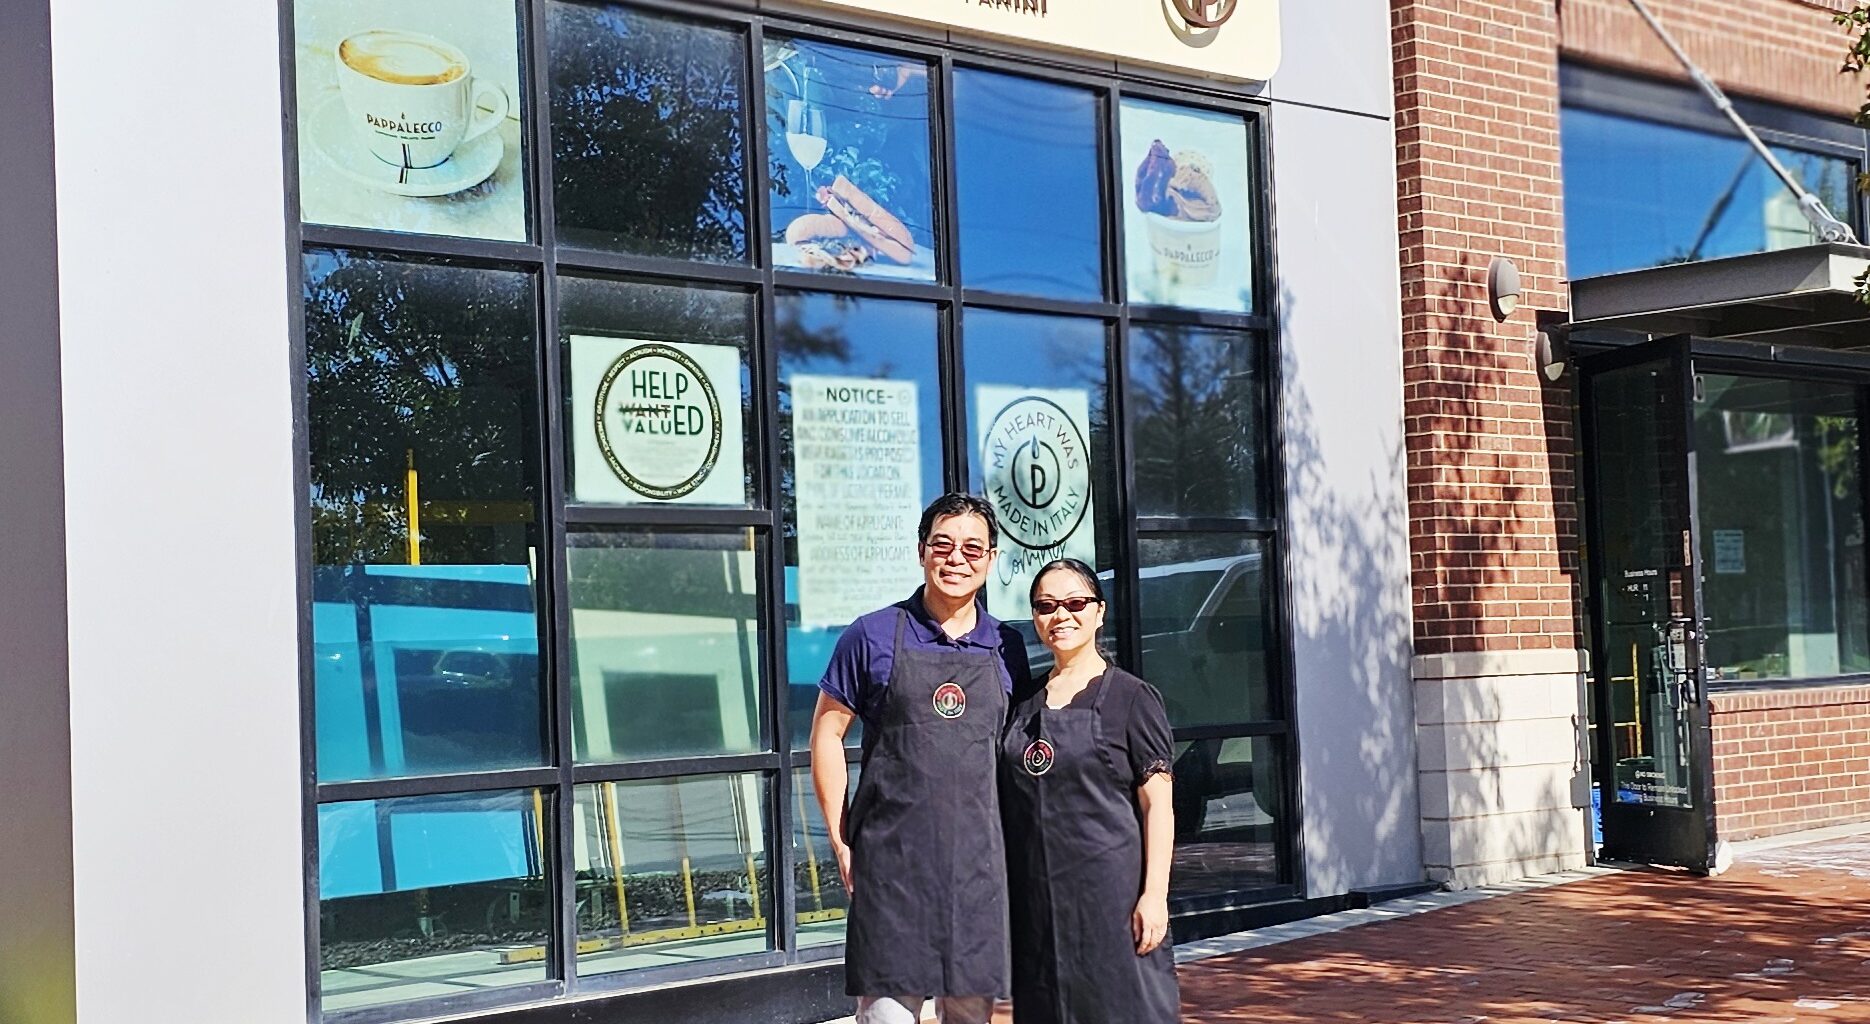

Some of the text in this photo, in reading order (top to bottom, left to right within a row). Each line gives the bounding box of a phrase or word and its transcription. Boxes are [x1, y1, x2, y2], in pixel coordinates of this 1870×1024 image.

[366, 113, 442, 134] PAPPALECCO
[632, 370, 688, 400] HELP
[993, 412, 1079, 470] MY HEART WAS
[993, 485, 1080, 536] MADE IN ITALY
